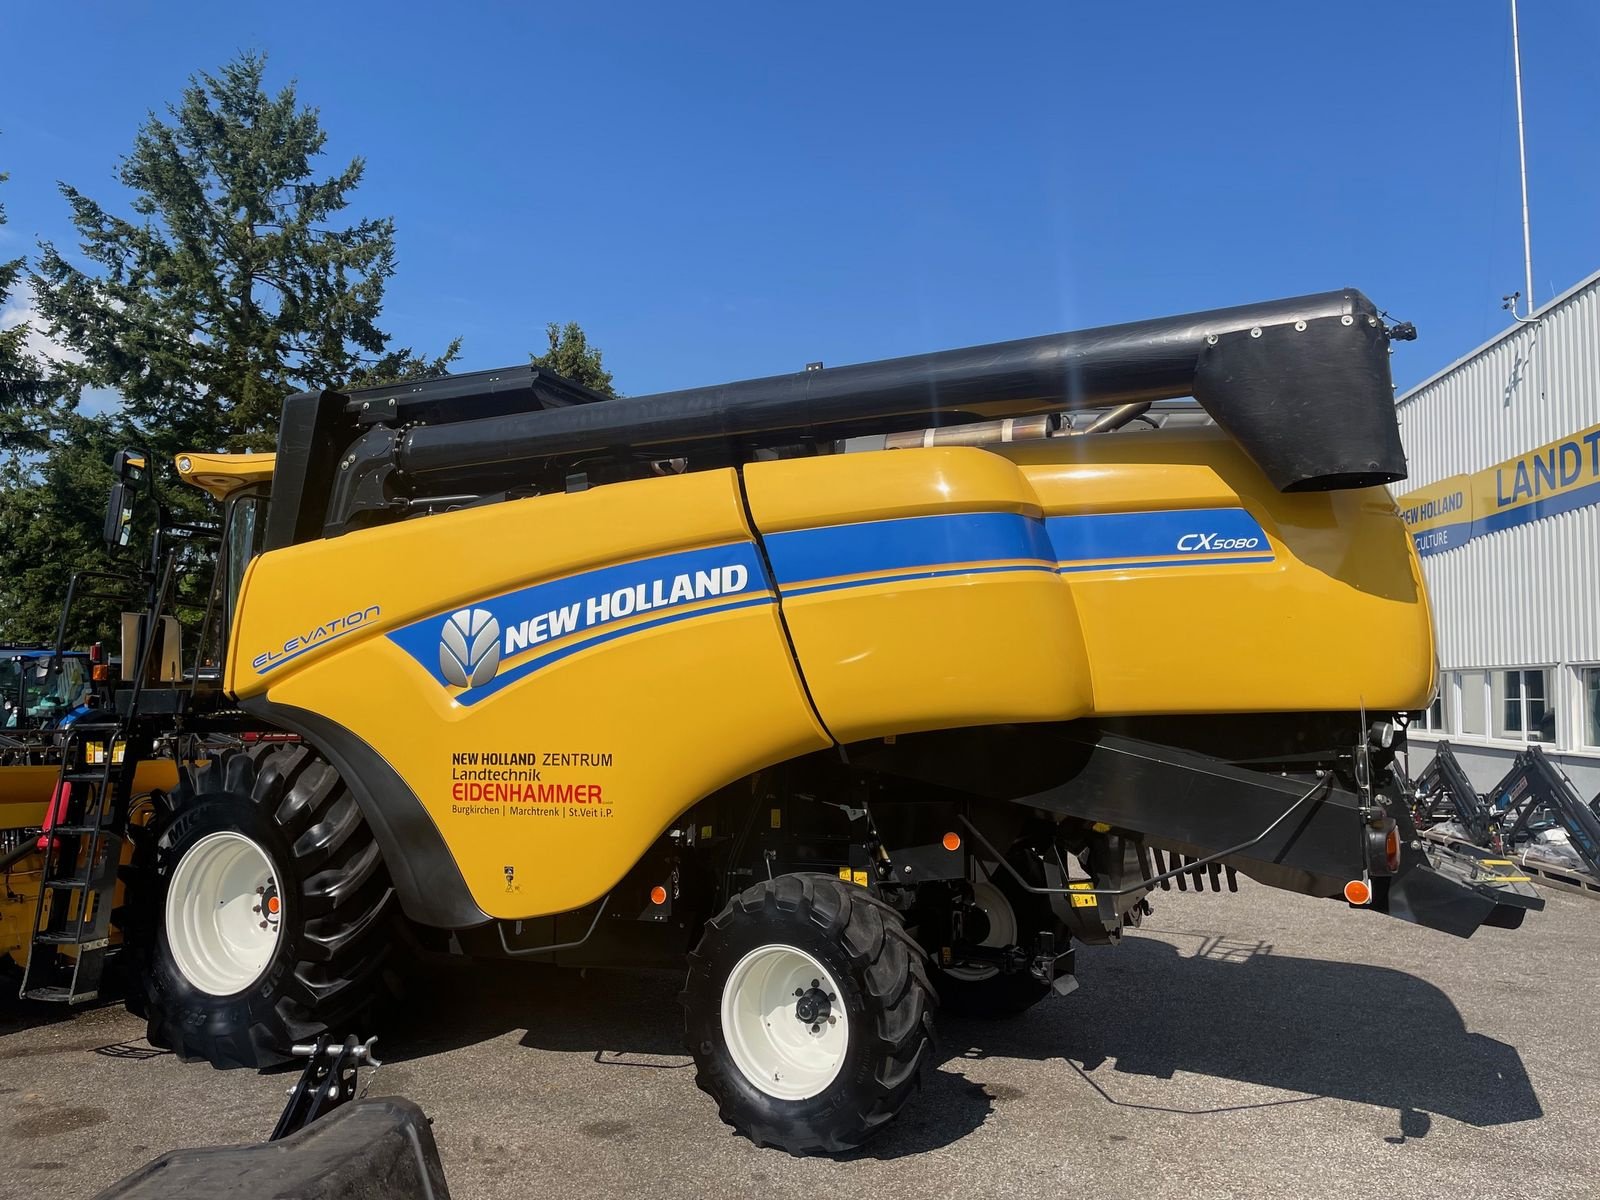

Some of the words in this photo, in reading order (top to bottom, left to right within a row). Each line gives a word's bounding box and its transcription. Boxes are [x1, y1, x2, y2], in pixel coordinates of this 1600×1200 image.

[1497, 430, 1600, 507] LANDT
[1420, 492, 1463, 521] HOLLAND
[1177, 533, 1258, 551] CX5080
[505, 602, 581, 654] NEW
[586, 564, 748, 625] HOLLAND
[252, 605, 380, 669] ELEVATION
[452, 753, 479, 766] NEW
[481, 753, 536, 766] HOLLAND
[542, 753, 613, 767] ZENTRUM
[452, 768, 541, 782] Landtechnik
[452, 782, 602, 804] EIDENHAMMER
[452, 804, 500, 816] Burgkirchen
[509, 806, 560, 817] Marchtrenk
[569, 807, 598, 818] St.Veit
